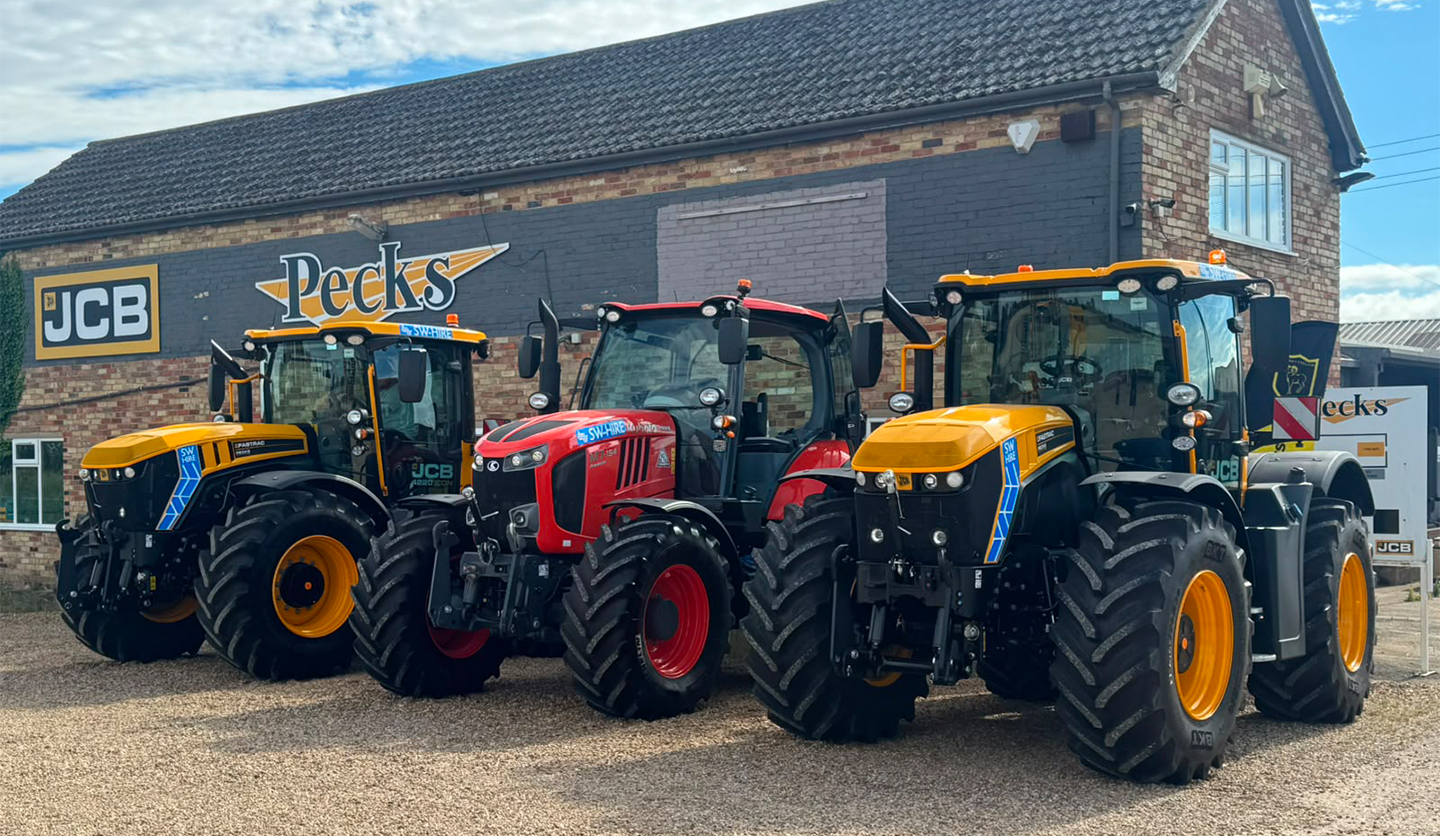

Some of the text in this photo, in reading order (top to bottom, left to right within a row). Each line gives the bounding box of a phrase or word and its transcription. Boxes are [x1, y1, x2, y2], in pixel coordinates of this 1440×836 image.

[280, 241, 456, 323] Pecks
[44, 284, 149, 342] JCB
[414, 325, 453, 339] SW-HIRE
[1322, 393, 1388, 417] ecks
[588, 420, 626, 441] SW-HIRE
[180, 446, 195, 457] SW
[1004, 439, 1015, 454] SW
[181, 455, 196, 464] HIRE
[412, 464, 454, 479] JCB
[1211, 460, 1239, 481] JCB
[1206, 542, 1227, 561] BKT
[1378, 543, 1411, 553] JCB
